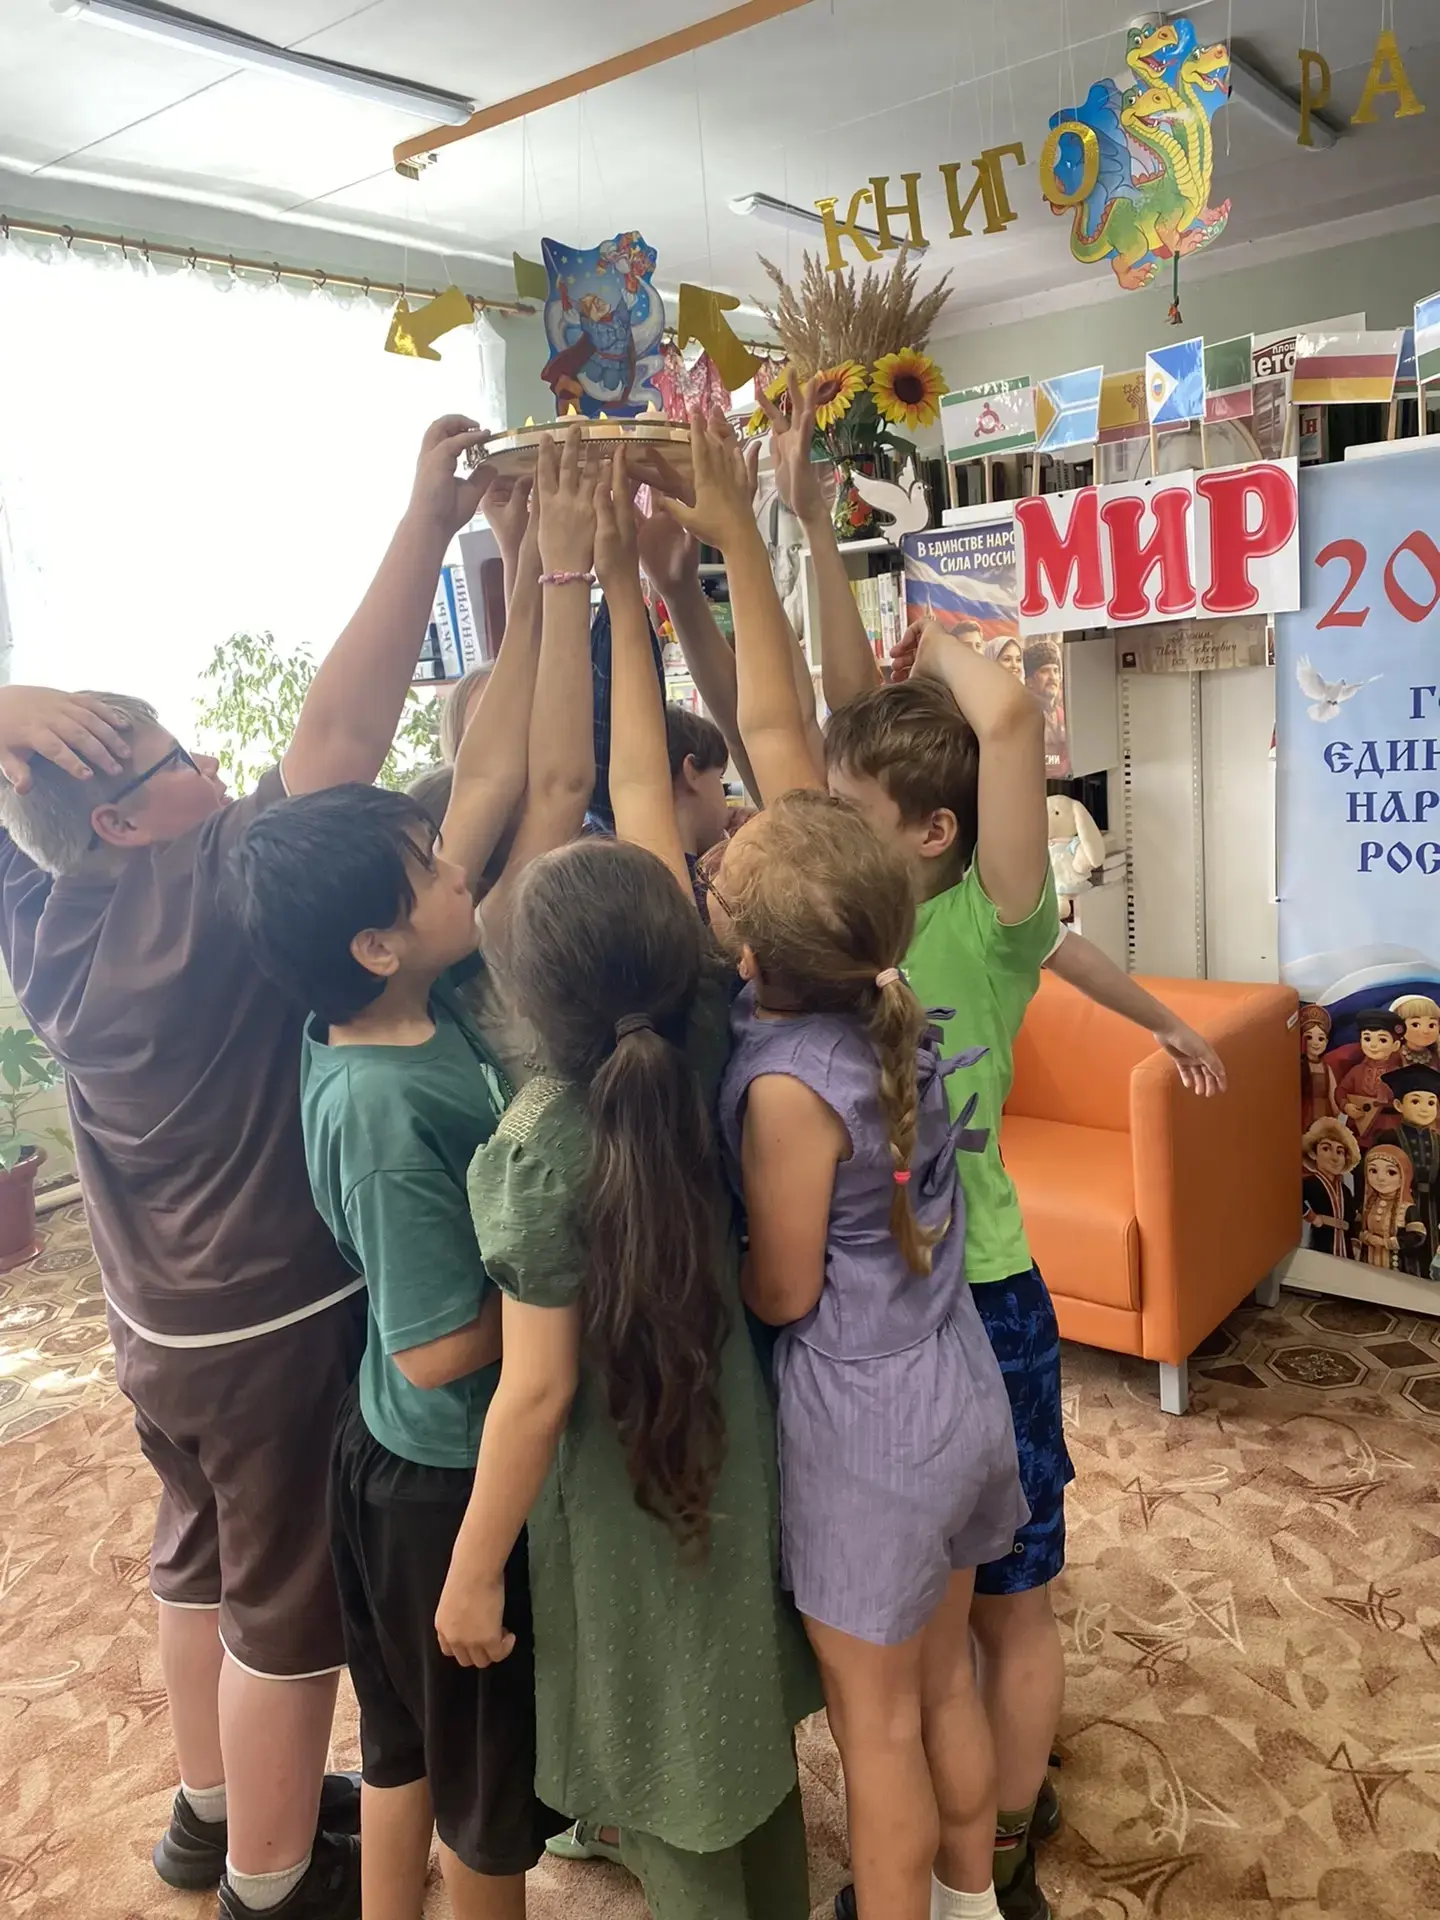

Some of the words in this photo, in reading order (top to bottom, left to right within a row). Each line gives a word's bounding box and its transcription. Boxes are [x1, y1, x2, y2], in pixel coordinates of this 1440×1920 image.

[917, 541, 927, 557] В
[928, 535, 984, 556] ЕДИНСТВЕ
[1014, 463, 1298, 621] МИР
[940, 556, 971, 573] СИЛА
[1409, 685, 1440, 719] Г
[1345, 790, 1440, 823] НАР
[1357, 841, 1440, 874] РОС
